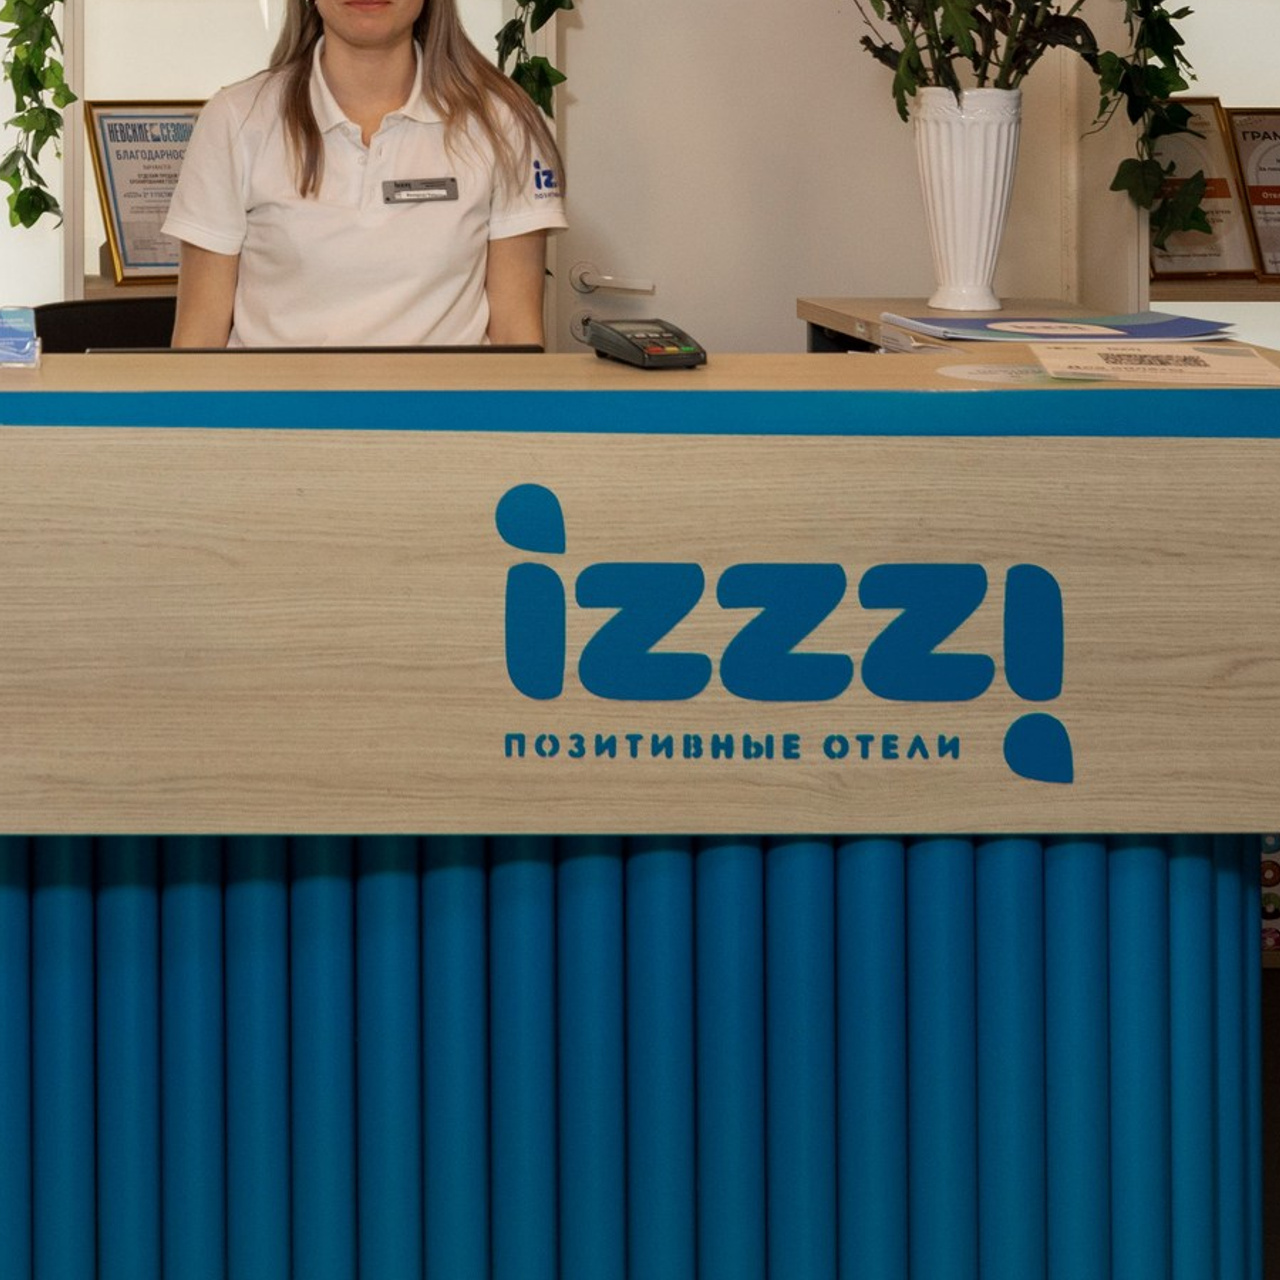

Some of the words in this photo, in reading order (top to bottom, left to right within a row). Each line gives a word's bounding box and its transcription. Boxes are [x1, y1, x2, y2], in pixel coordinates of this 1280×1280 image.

[108, 123, 151, 143] НЕВСКИЕ
[504, 732, 802, 760] ПОЗИТИВНЫЕ
[822, 732, 962, 761] ОТЕЛИ
